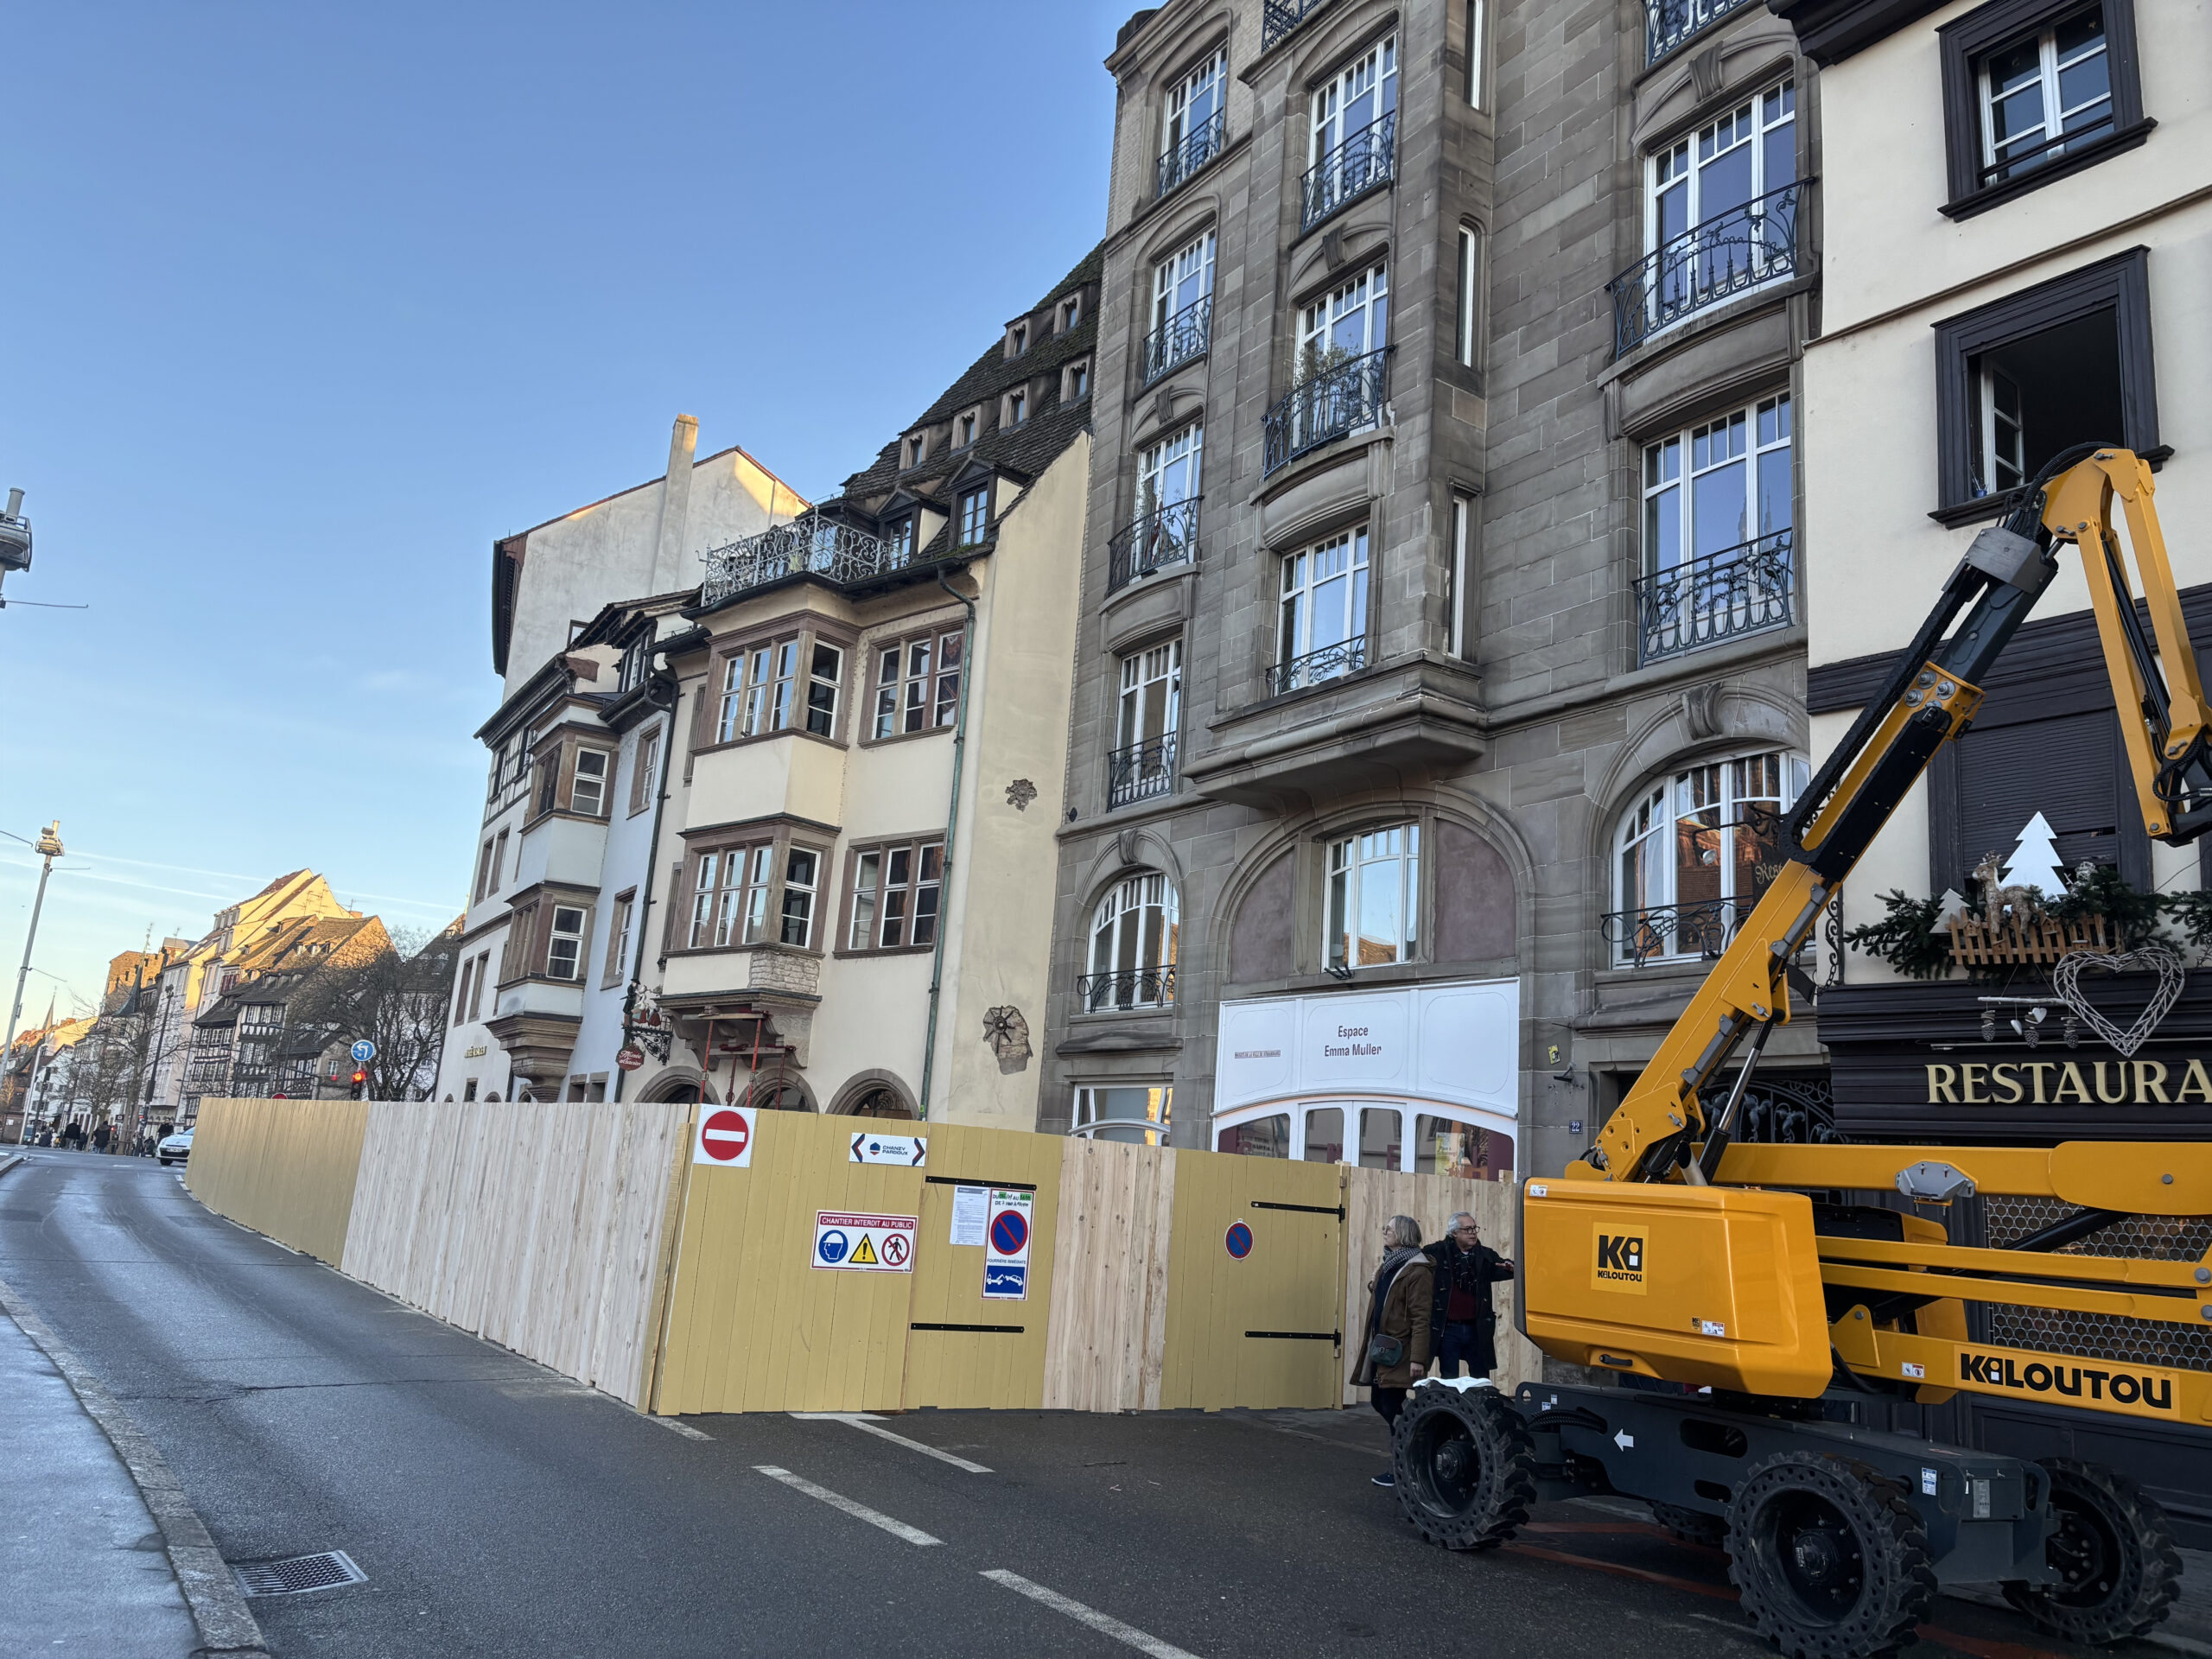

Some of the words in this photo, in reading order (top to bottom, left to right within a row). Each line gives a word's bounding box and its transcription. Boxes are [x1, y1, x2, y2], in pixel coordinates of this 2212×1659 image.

[1338, 1026, 1369, 1039] Espace
[1325, 1045, 1350, 1057] Emma
[1352, 1043, 1382, 1056] Muller
[1925, 1059, 2212, 1104] RESTAURA
[1571, 1122, 1580, 1132] 22
[822, 1217, 853, 1225] CHANTIER
[854, 1218, 880, 1227] INTERDIT
